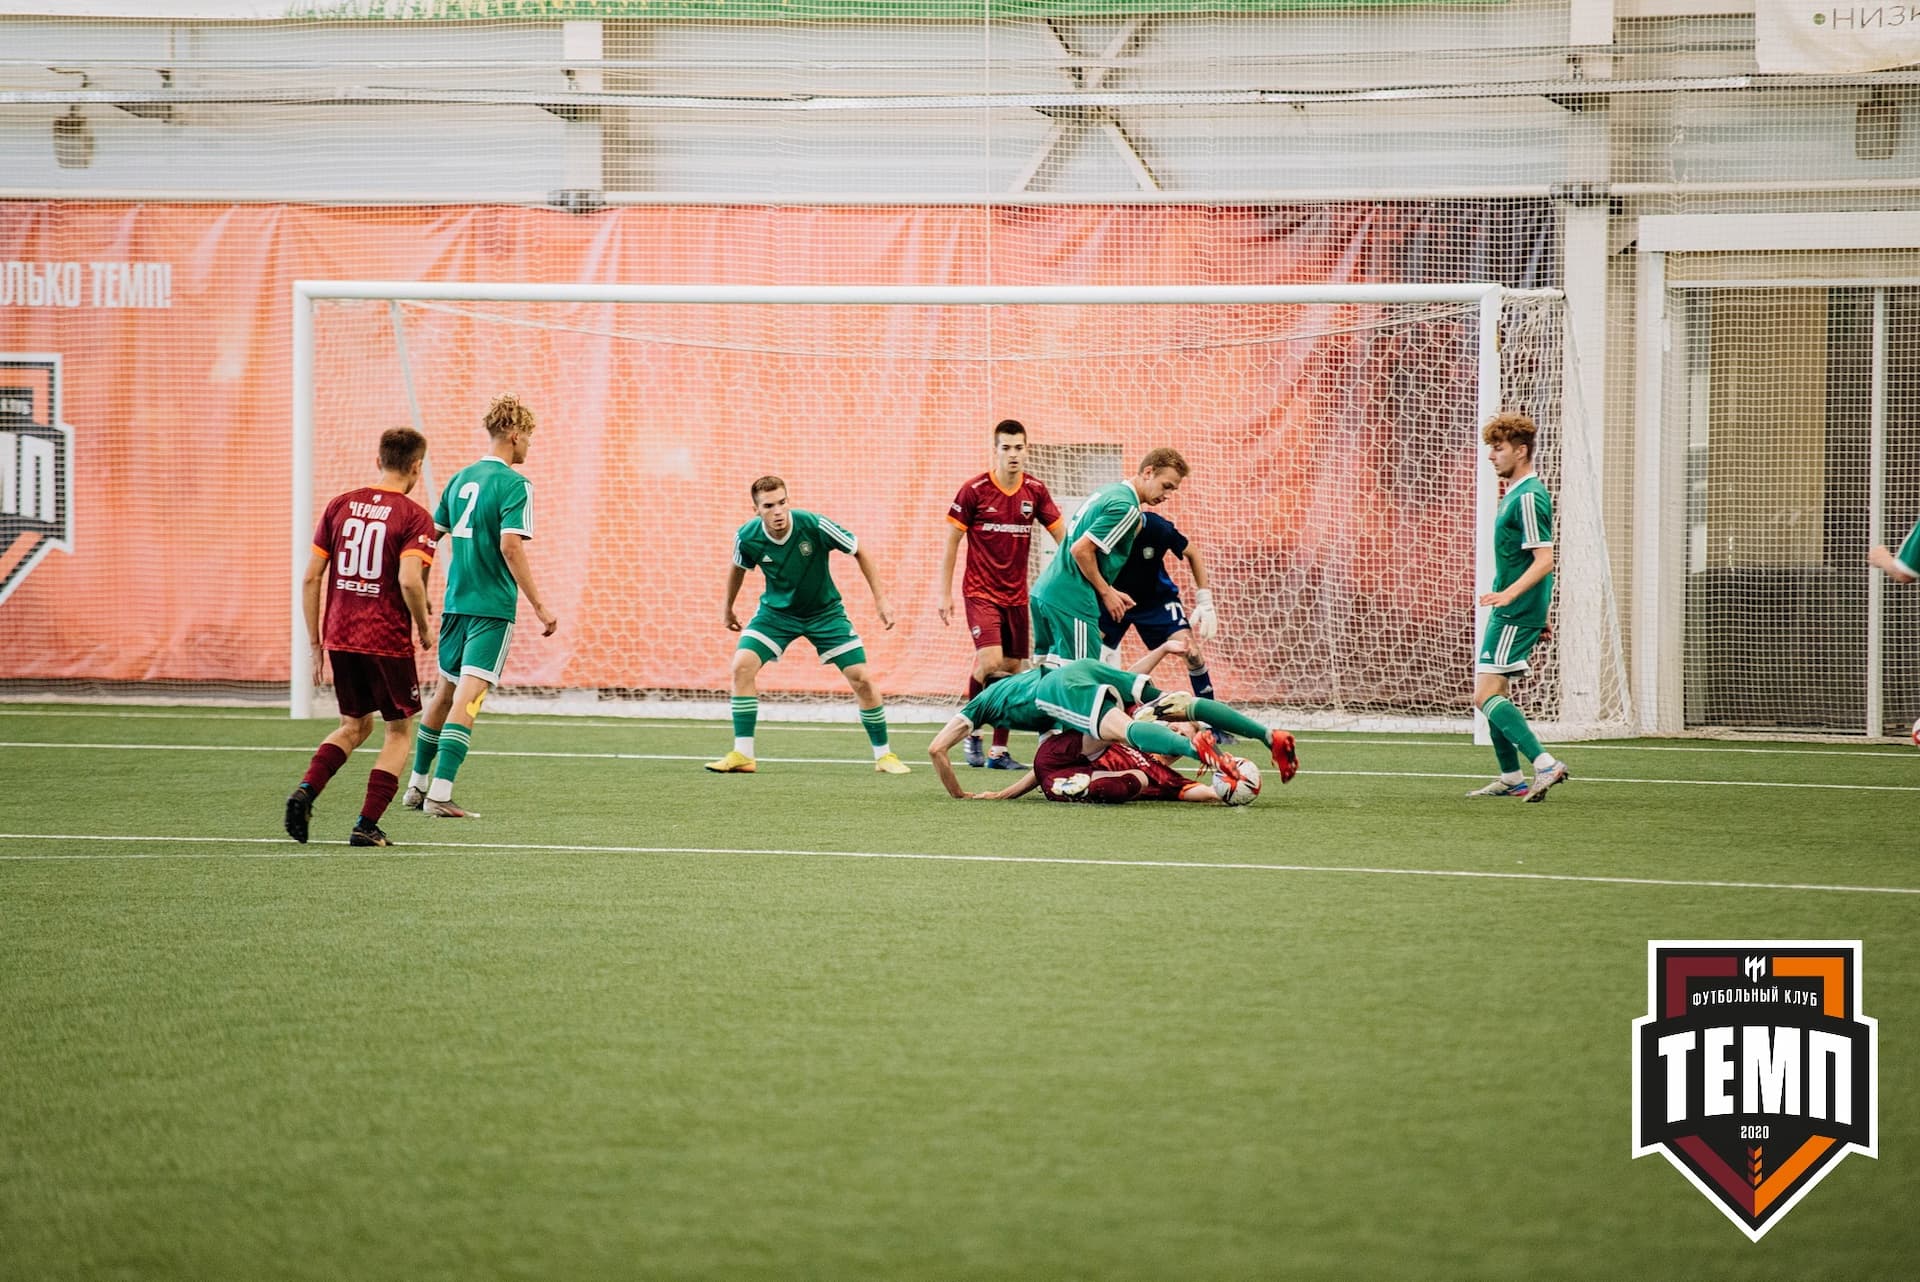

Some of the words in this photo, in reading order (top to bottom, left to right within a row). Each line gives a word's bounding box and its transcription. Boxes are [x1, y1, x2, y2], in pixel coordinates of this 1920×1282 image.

[0, 262, 80, 307] ЛЬКО
[90, 262, 171, 308] ТЕМП!
[349, 501, 392, 521] ЧЕРНОВ
[452, 481, 480, 538] 2
[337, 517, 387, 579] 30
[336, 579, 380, 594] SEUS
